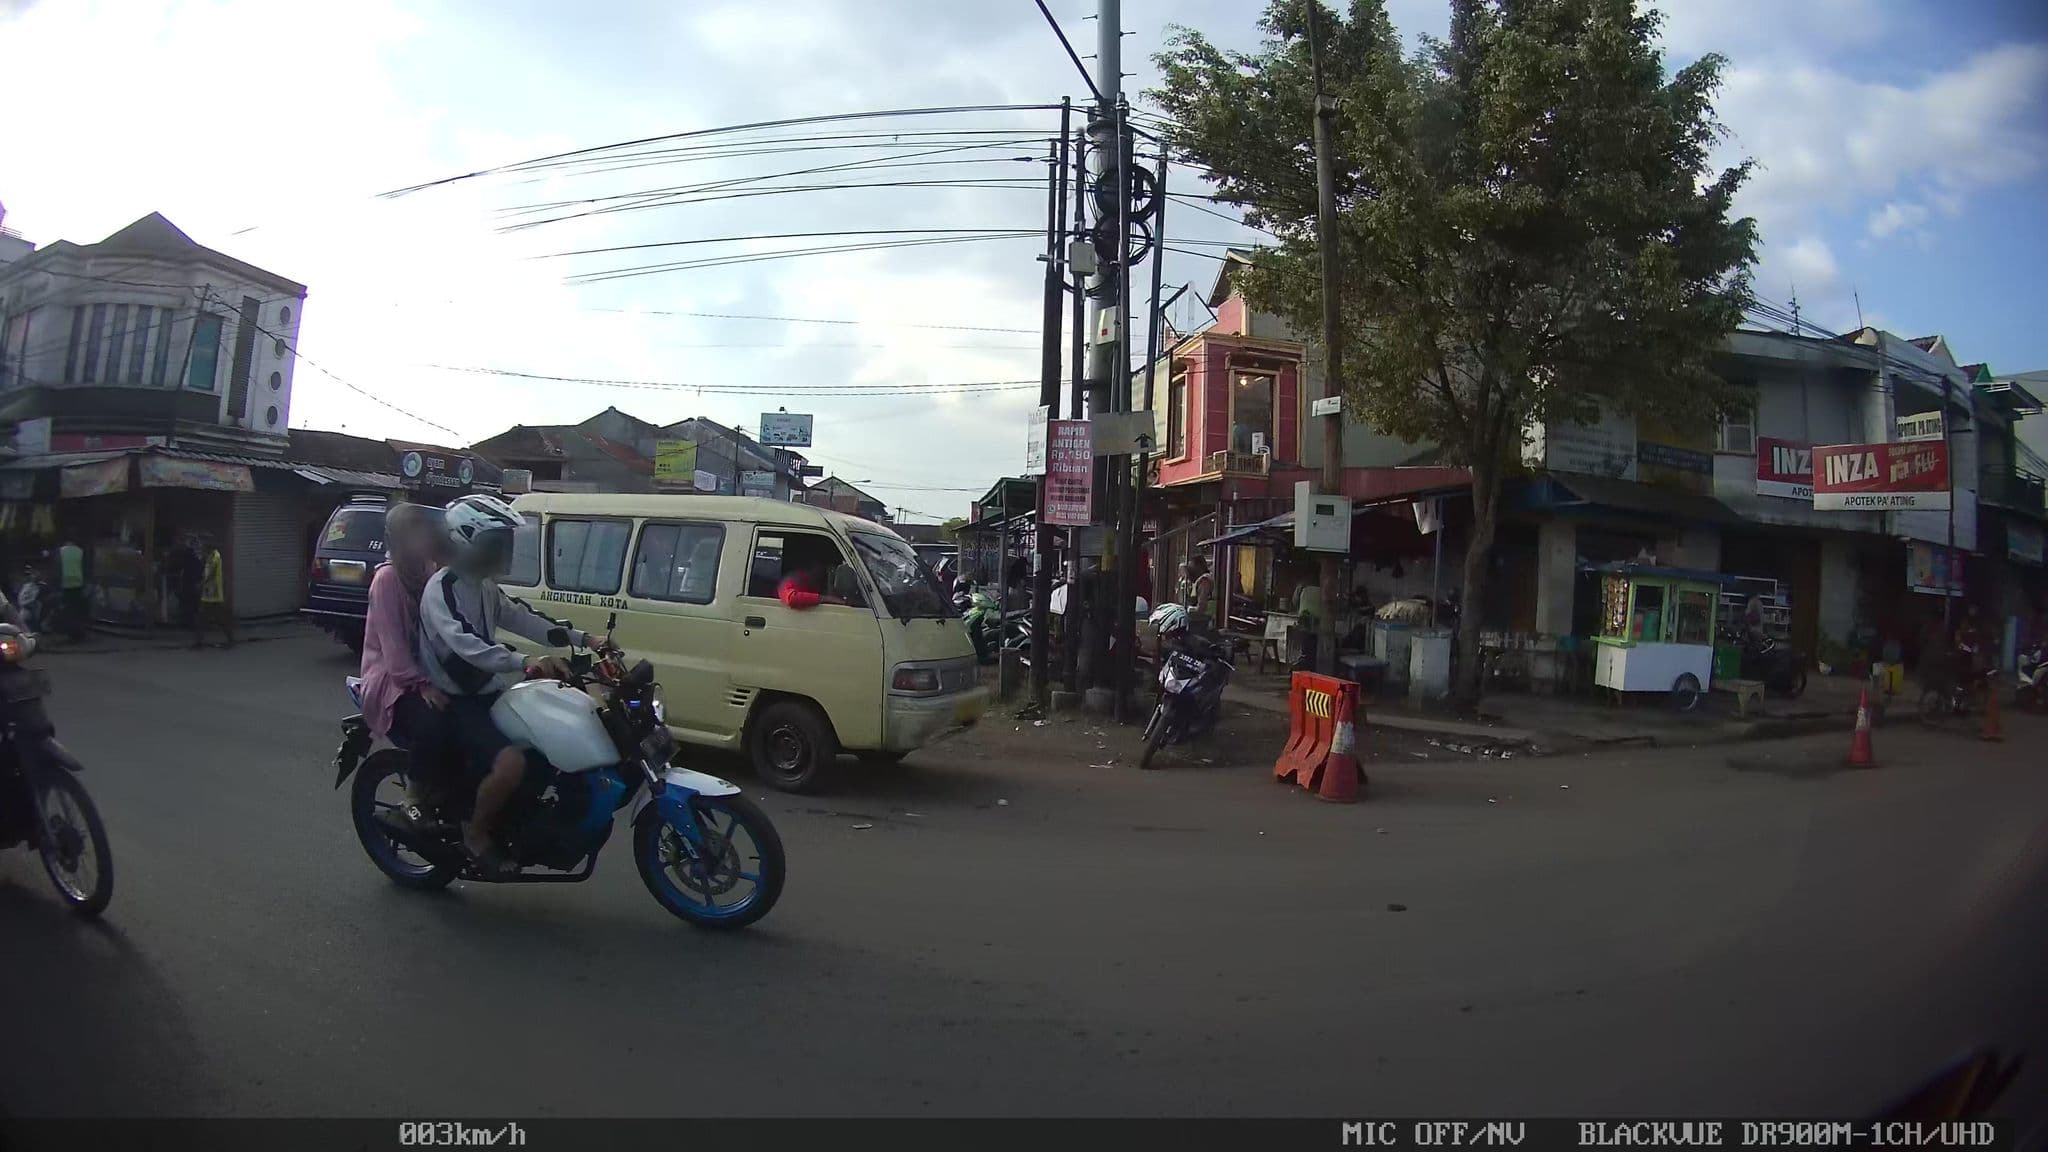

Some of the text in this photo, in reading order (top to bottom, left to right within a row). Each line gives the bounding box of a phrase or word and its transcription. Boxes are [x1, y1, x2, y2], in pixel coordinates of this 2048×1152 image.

[1058, 426, 1086, 436] RAPID
[1897, 421, 1917, 438] APOTEK
[1052, 439, 1090, 449] ANTIGEN
[1052, 462, 1088, 473] Ribuan
[1825, 452, 1879, 486] INZA
[1844, 495, 1876, 506] APOTEK
[1890, 495, 1916, 506] ATING
[600, 596, 628, 610] KOTA
